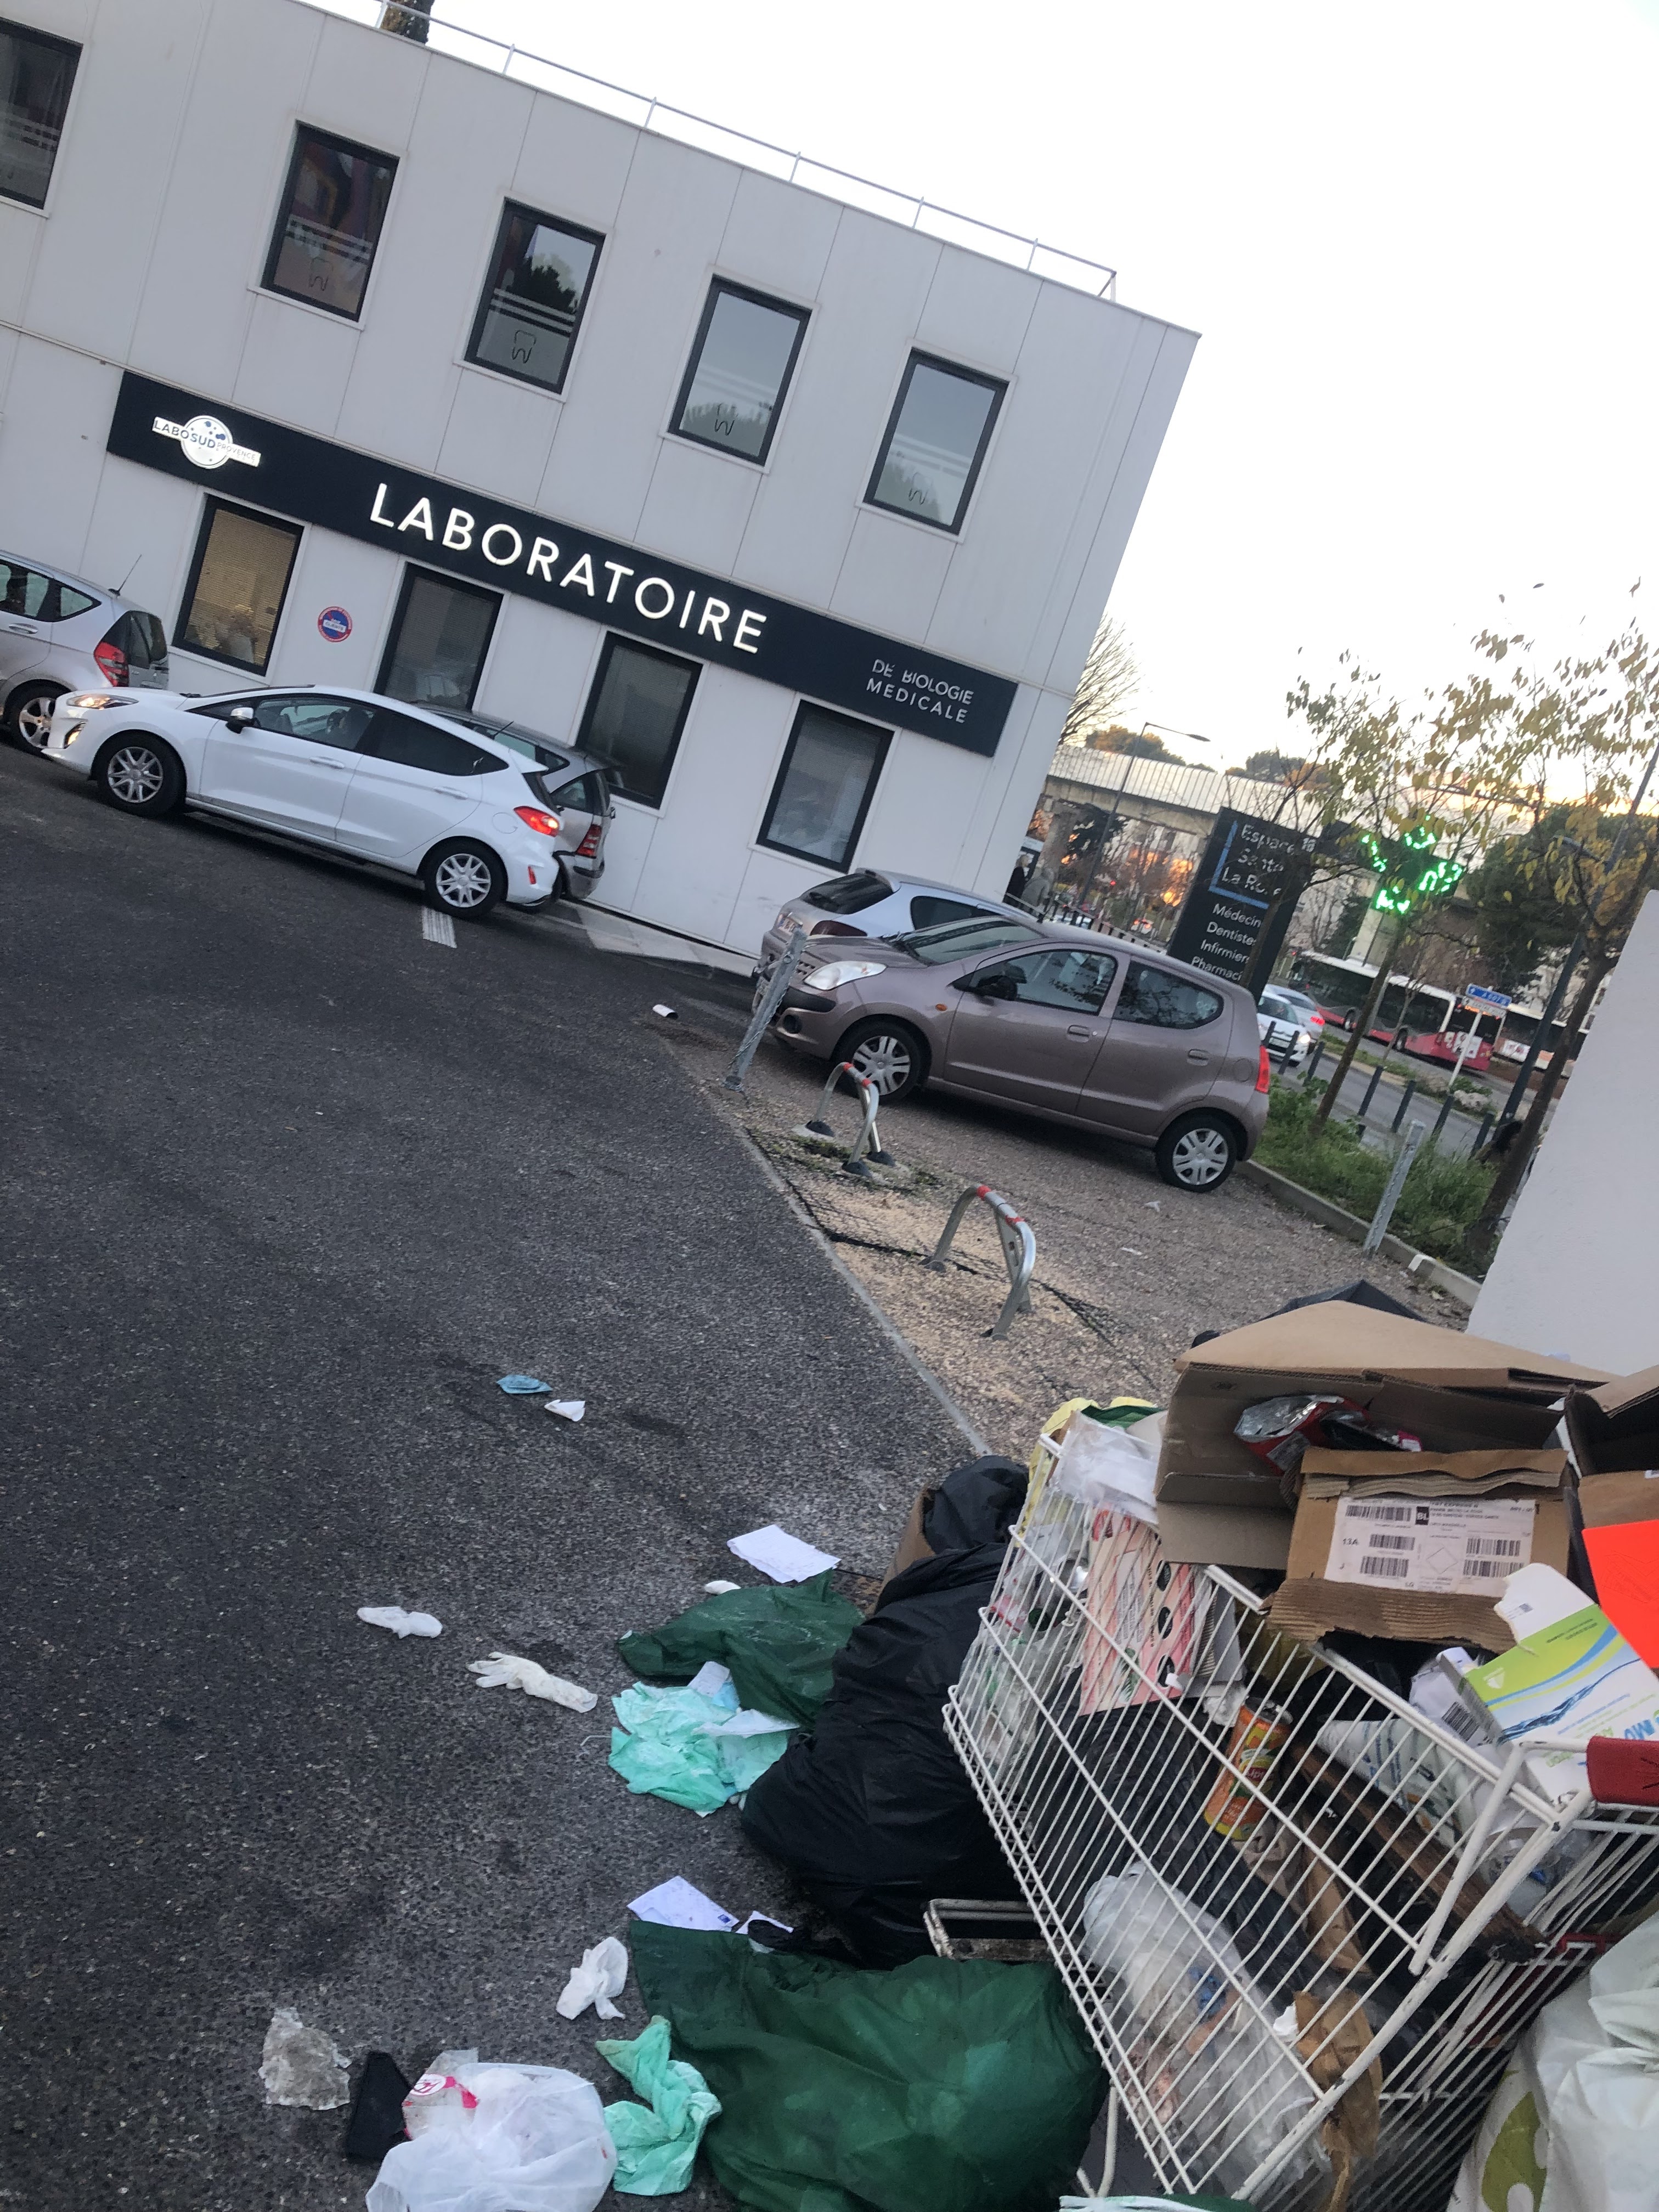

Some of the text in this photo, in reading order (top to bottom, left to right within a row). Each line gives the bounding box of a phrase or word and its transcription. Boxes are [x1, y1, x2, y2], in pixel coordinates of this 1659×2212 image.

[217, 442, 256, 460] PROVENCE
[370, 483, 768, 654] LABORATOIRE
[866, 678, 968, 724] MEDICALE
[1222, 866, 1241, 885] La
[1212, 903, 1262, 928] Médecin
[1192, 956, 1244, 981] Pharmaci
